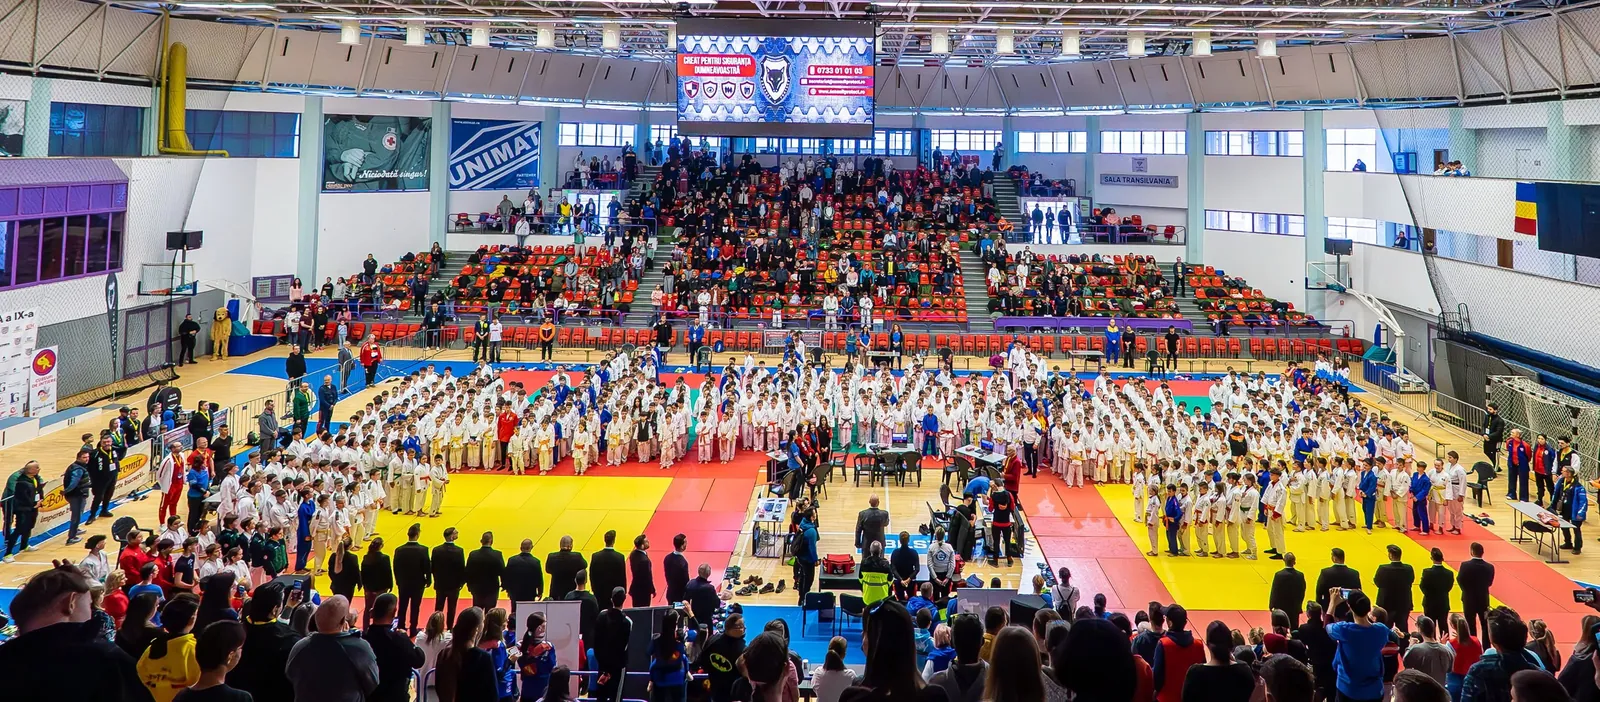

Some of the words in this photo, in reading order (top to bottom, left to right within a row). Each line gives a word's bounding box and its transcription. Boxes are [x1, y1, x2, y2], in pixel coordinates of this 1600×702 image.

[449, 127, 539, 186] UNIMAT
[399, 169, 427, 179] singur!
[1123, 176, 1171, 185] TRANSILVANIA
[15, 311, 34, 320] IX-a
